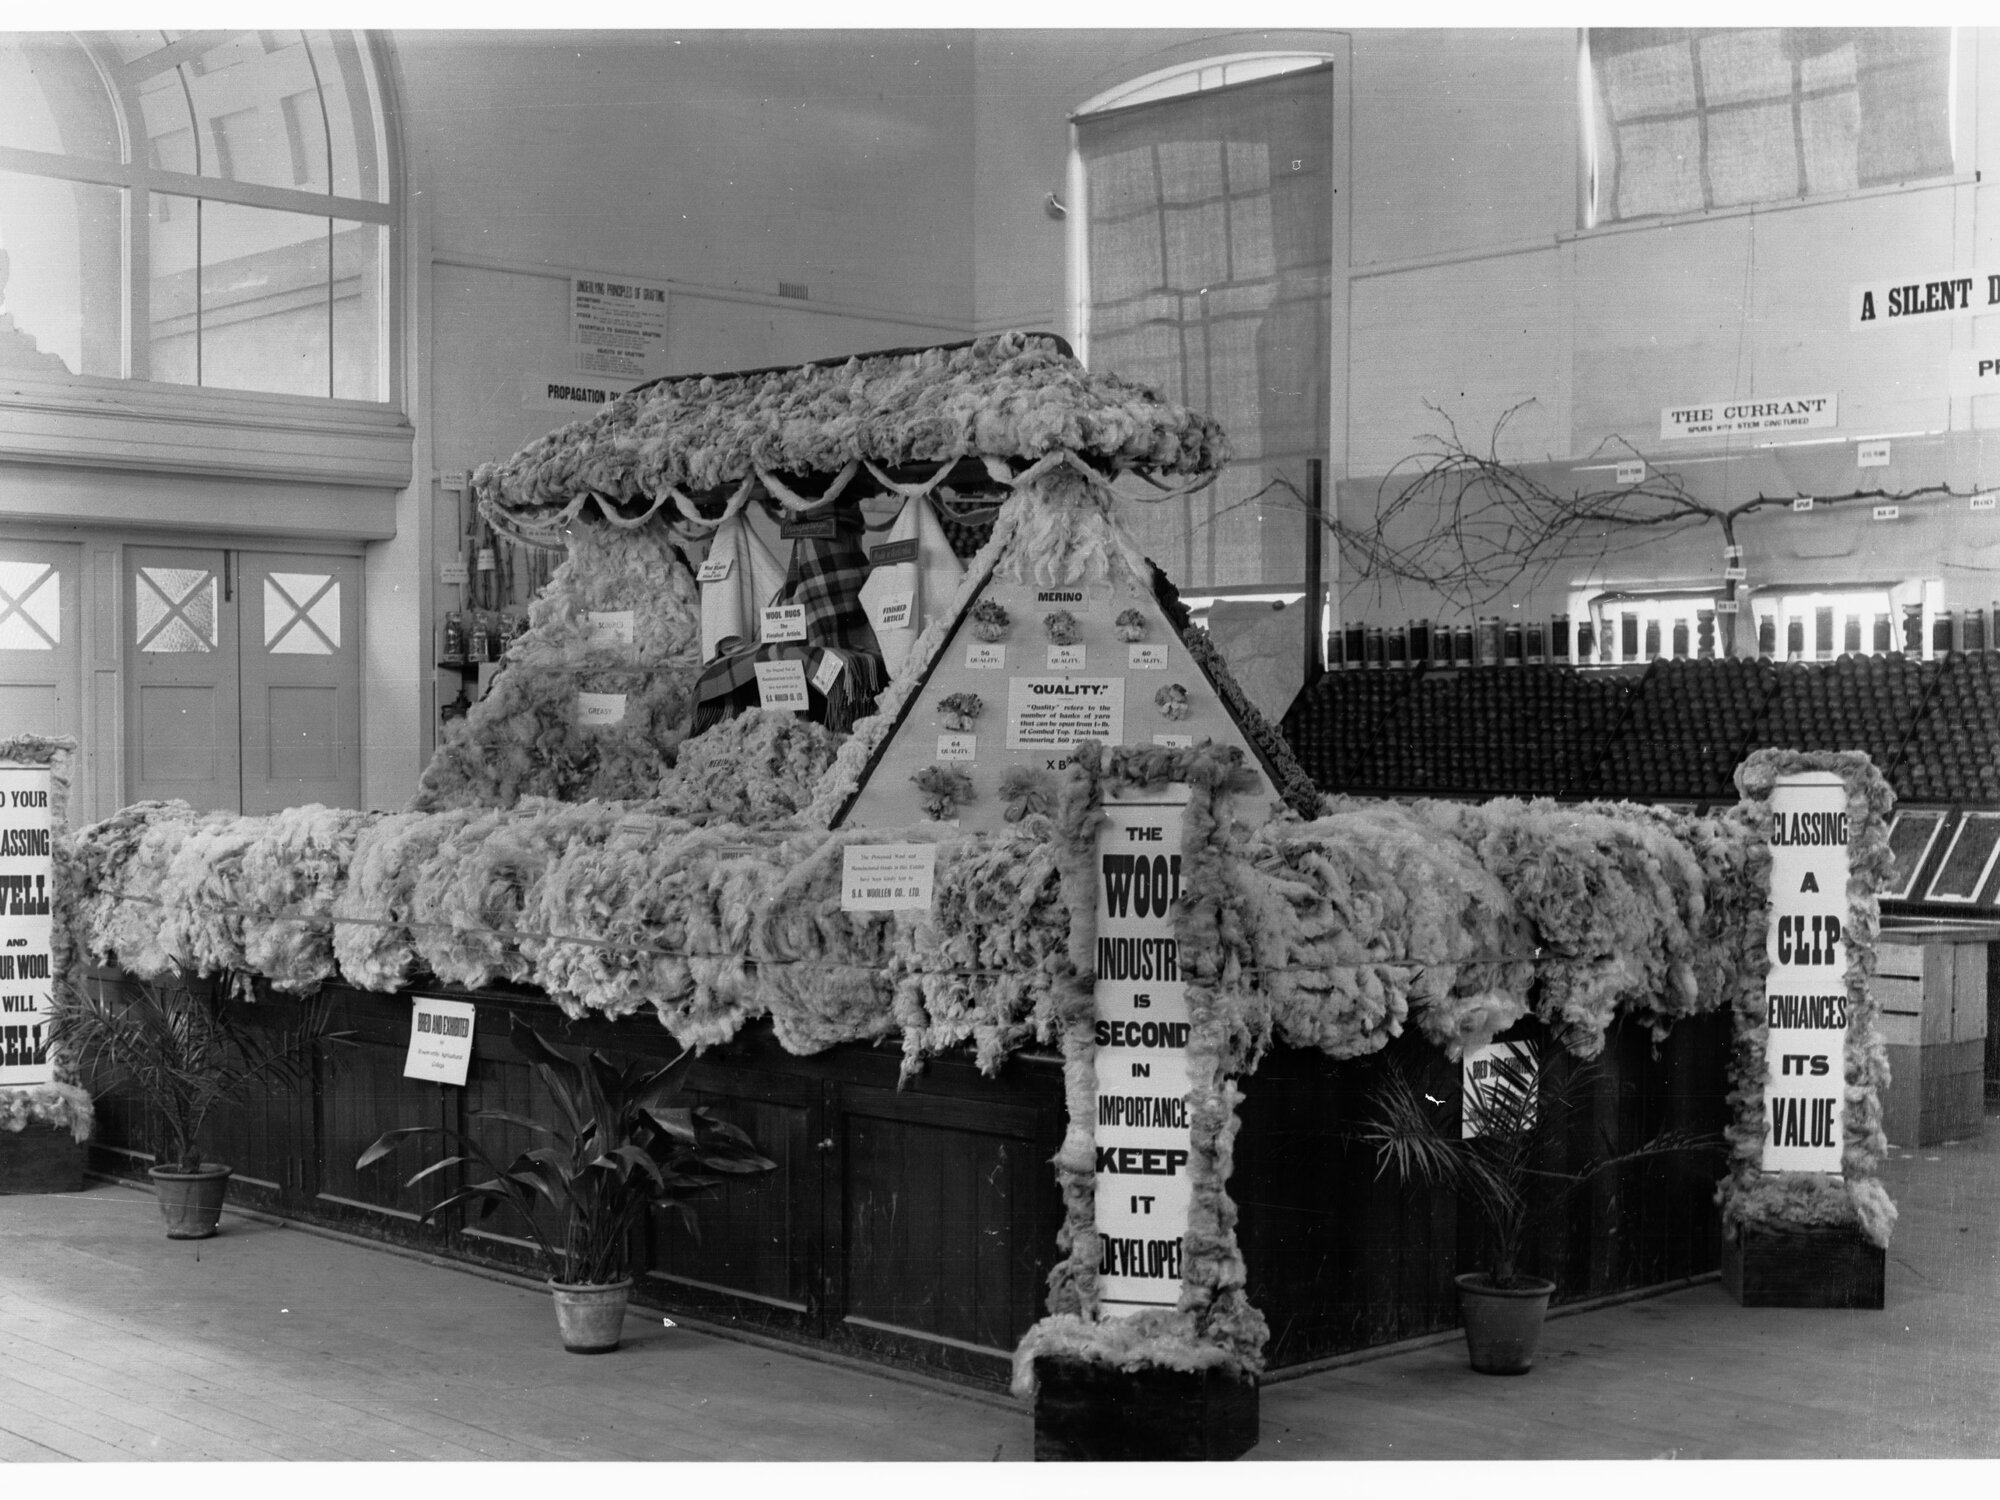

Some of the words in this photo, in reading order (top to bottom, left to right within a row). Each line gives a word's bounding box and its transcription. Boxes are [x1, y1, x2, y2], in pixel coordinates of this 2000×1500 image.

[1861, 291, 1876, 321] A
[1888, 278, 1972, 318] SILENT
[548, 384, 605, 403] PROPAGATION
[1671, 409, 1713, 423] THE
[1724, 399, 1826, 420] CURRANT
[1737, 421, 1760, 429] STEM
[1038, 592, 1082, 602] MERINO
[766, 611, 782, 620] WOOL
[785, 609, 801, 618] RUGS
[883, 604, 907, 615] FINISHED
[883, 613, 905, 623] ARTICLE
[588, 707, 612, 715] GREASY
[11, 790, 47, 808] YOUR
[1126, 827, 1163, 841] THE
[1771, 812, 1848, 846] CLASSING
[0, 829, 49, 856] ASSING
[1103, 854, 1187, 919] WOOL
[1800, 872, 1820, 893] A
[867, 888, 891, 898] WOOLLEN
[6, 938, 28, 947] AND
[1778, 915, 1840, 965] CLIP
[17, 953, 51, 979] WOOL
[2, 995, 37, 1013] WILL
[1134, 994, 1151, 1009] IS
[1769, 995, 1847, 1029] ENHANCES
[432, 1014, 442, 1035] AND
[1095, 1020, 1191, 1048] SECOND
[1131, 1063, 1150, 1078] IN
[1782, 1054, 1830, 1076] ITS
[1098, 1095, 1189, 1129] IMPORTANCE
[1772, 1097, 1836, 1148] VALUE
[1096, 1146, 1189, 1176] KEEP
[1131, 1196, 1155, 1215] IT
